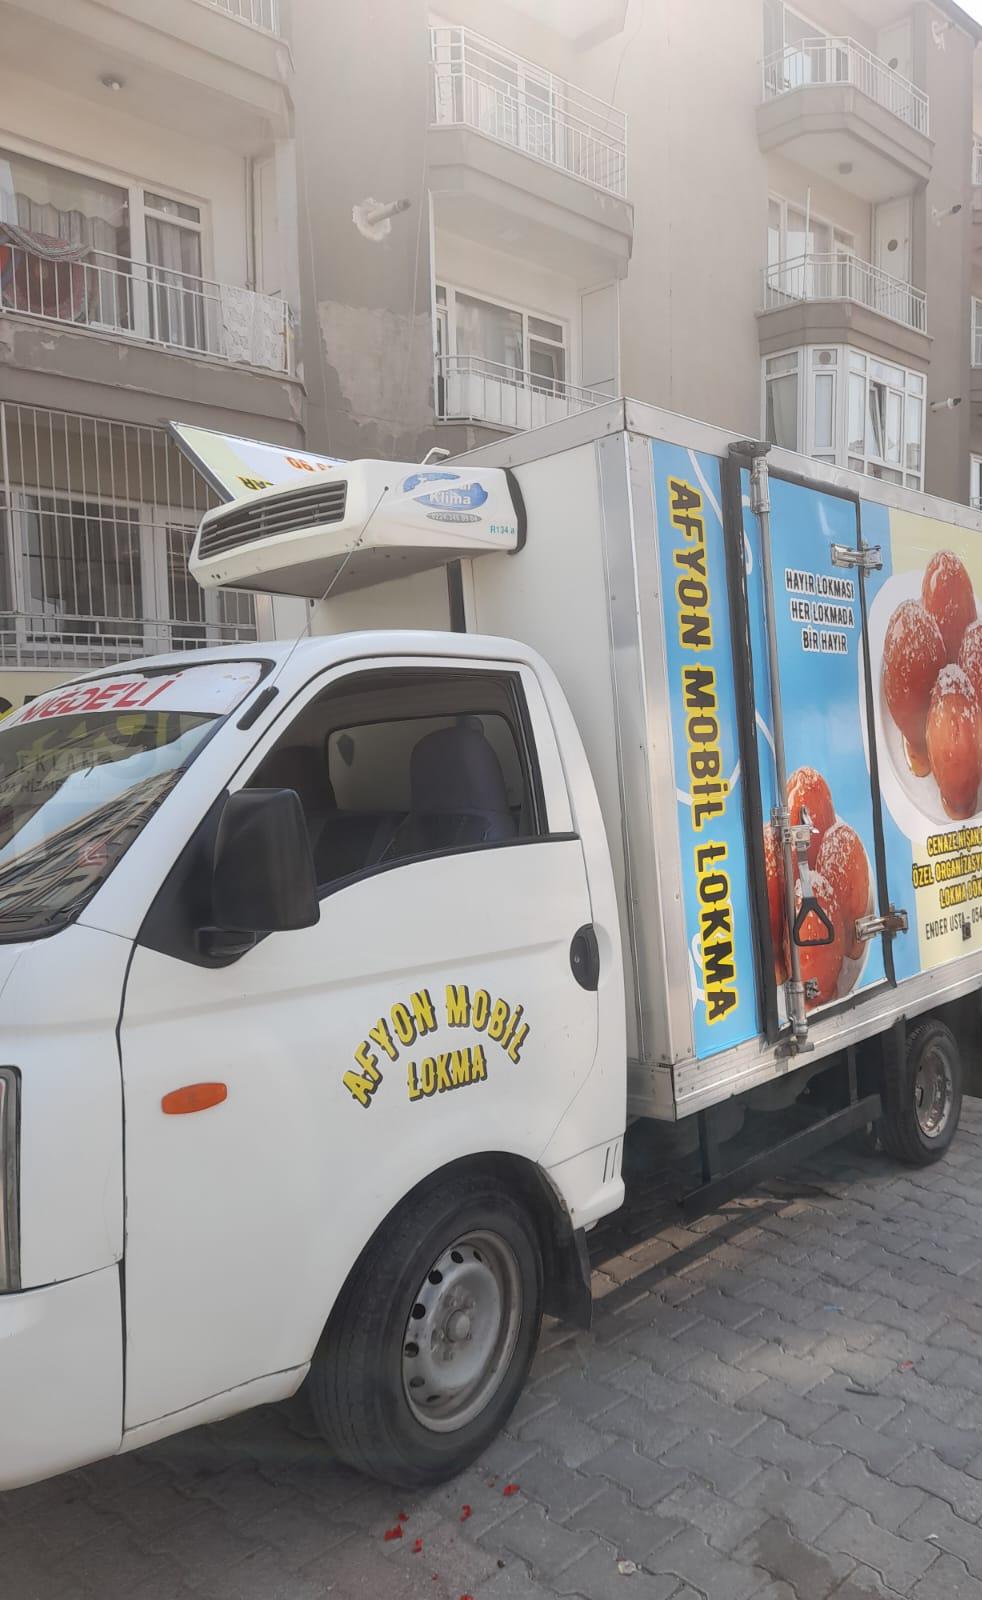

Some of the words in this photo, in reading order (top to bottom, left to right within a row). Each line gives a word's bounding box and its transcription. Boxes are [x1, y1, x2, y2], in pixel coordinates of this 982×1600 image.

[430, 490, 471, 505] Klima
[666, 475, 715, 654] AFYON
[785, 568, 815, 594] HAYIR
[816, 574, 854, 600] LOKMASI
[791, 599, 810, 622] HER
[812, 602, 854, 628] LOKMADA
[802, 625, 819, 651] BİR
[820, 630, 847, 653] HAYIR
[680, 661, 730, 833] MOBİL
[912, 863, 934, 889] ÖZEL
[939, 883, 967, 909] LOKMA
[694, 837, 739, 1026] LOKMA
[925, 918, 949, 940] ENDER
[342, 988, 438, 1108] AFYON
[445, 984, 530, 1064] MOBİL
[407, 1044, 488, 1101] LOKMA
